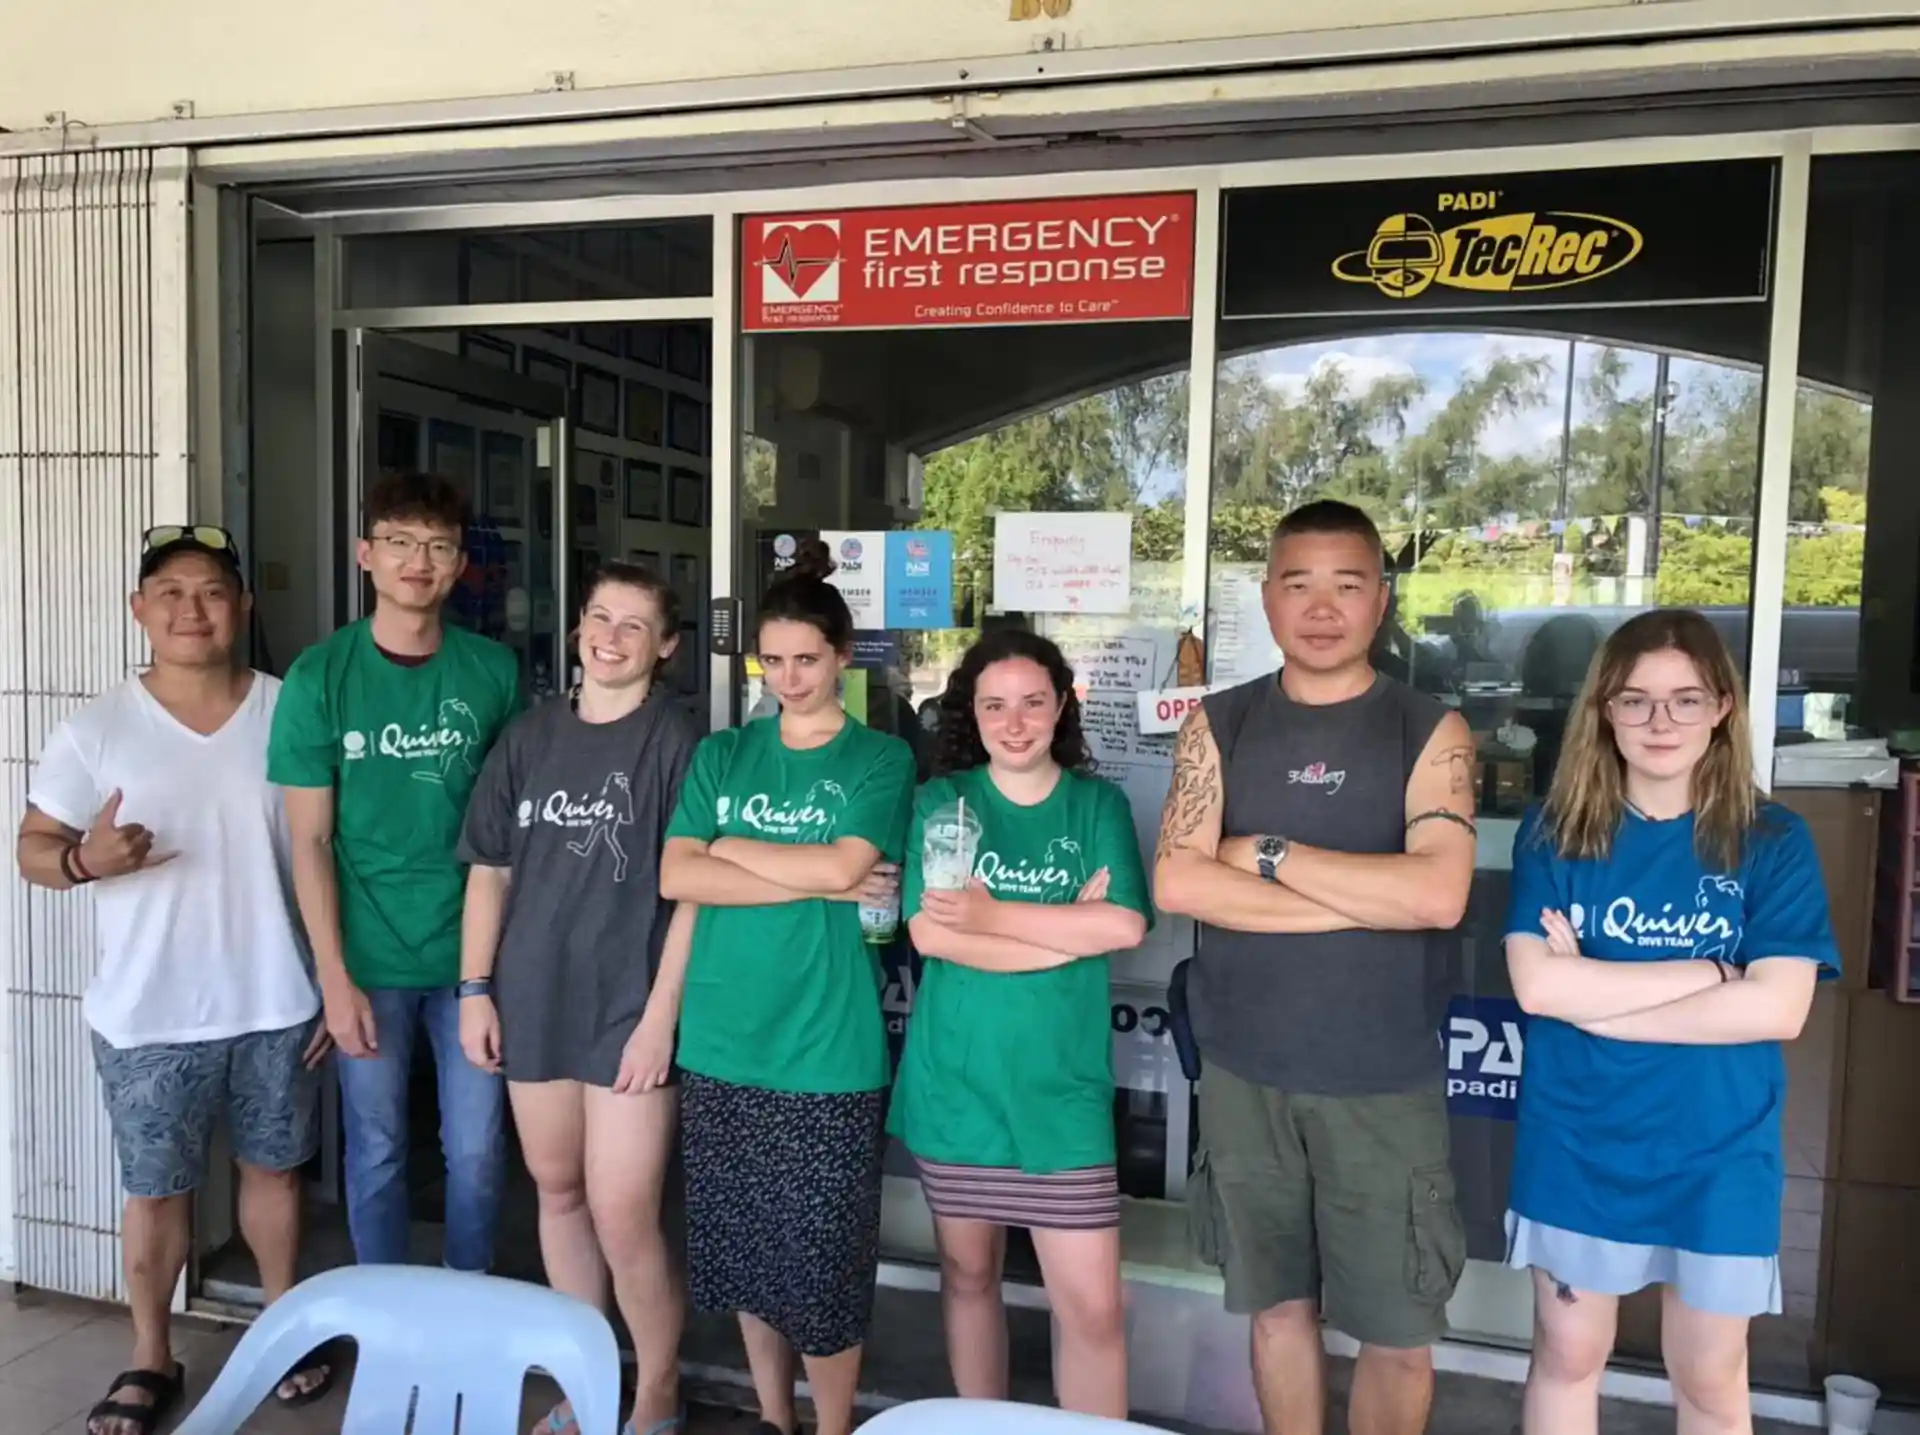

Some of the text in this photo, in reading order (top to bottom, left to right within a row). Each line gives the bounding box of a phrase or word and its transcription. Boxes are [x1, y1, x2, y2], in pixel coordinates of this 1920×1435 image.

[1438, 190, 1496, 212] PADI
[865, 215, 1168, 258] EMERGENCY
[1448, 224, 1610, 278] TecRec
[862, 256, 1165, 289] first response
[762, 304, 840, 316] EMERGENCY
[914, 300, 1111, 318] Creating Confidence to Care
[742, 793, 827, 830] Quiver
[973, 851, 1070, 890] Quiver
[1603, 896, 1734, 944] Quiver
[1637, 935, 1695, 947] DIVE TEAM
[1448, 1016, 1523, 1076] PA
[1446, 1078, 1518, 1100] padi
